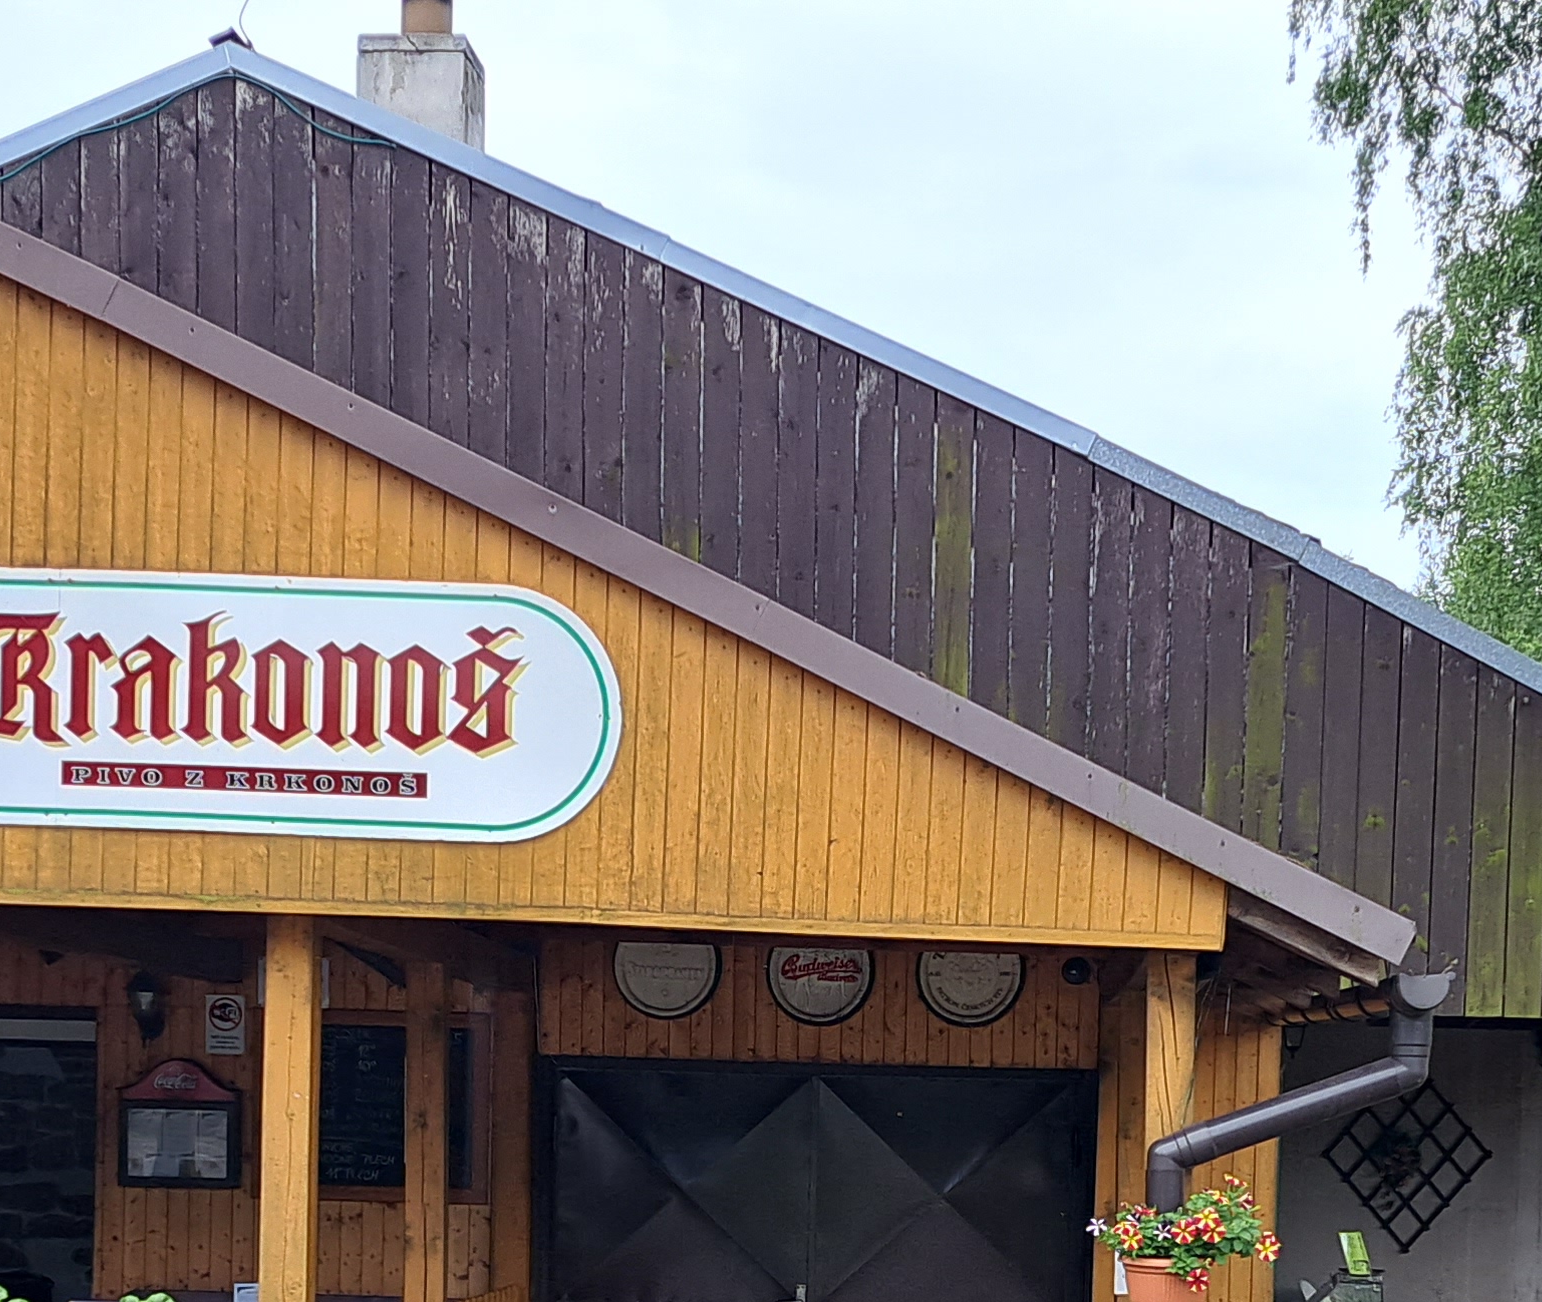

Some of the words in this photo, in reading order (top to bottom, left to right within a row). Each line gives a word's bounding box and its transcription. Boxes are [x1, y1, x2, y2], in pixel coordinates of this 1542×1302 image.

[71, 767, 162, 785] PIVO
[185, 769, 205, 787] Z
[225, 771, 417, 796] KRKONOŠ
